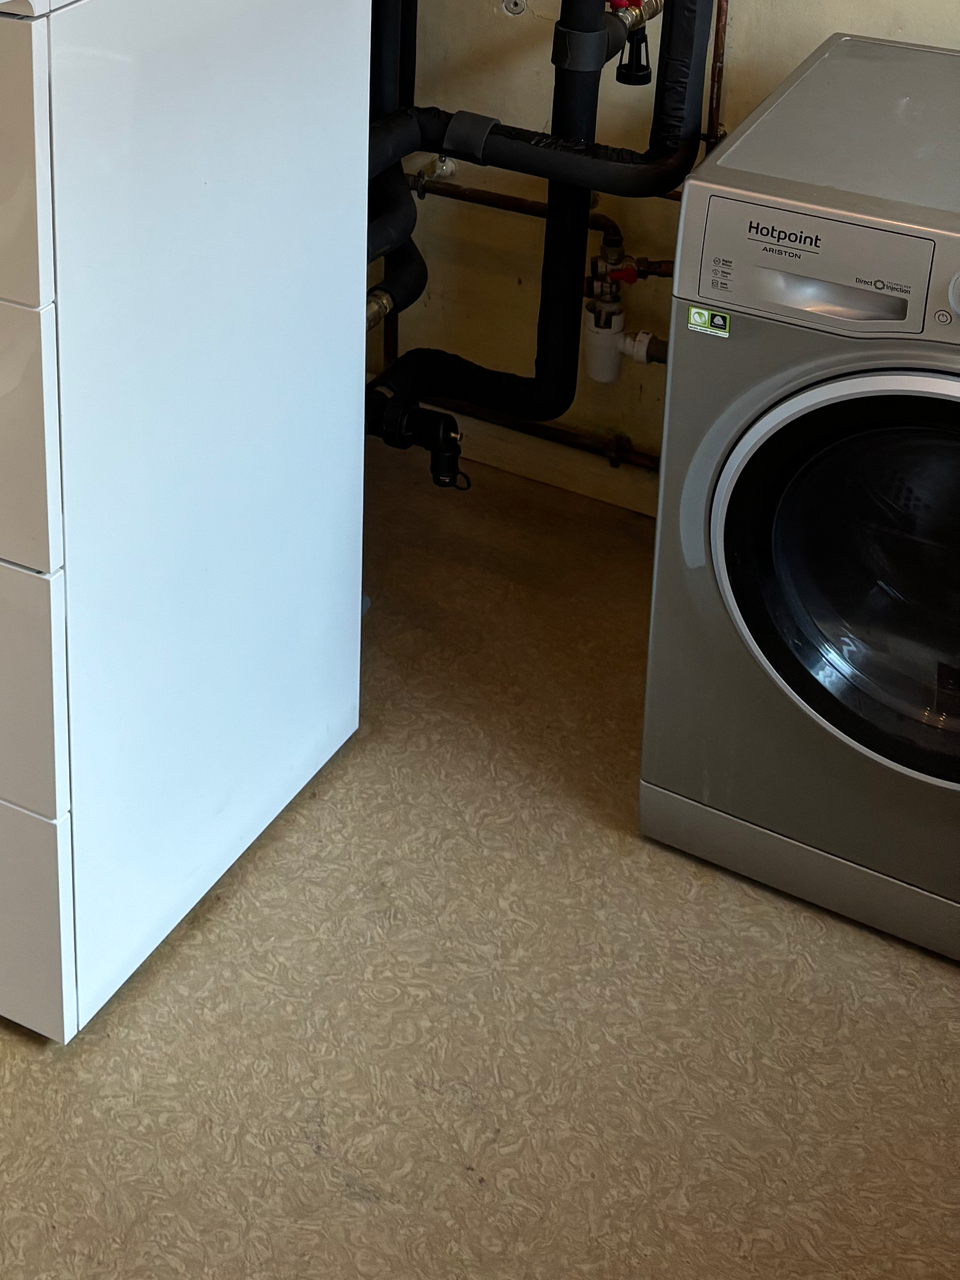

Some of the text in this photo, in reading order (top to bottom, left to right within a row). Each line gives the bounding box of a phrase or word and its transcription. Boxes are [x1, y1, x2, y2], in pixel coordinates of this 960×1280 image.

[748, 221, 821, 248] Hotpoint
[762, 246, 801, 259] ARISTON
[855, 277, 873, 287] Direct
[886, 284, 911, 295] Injection
